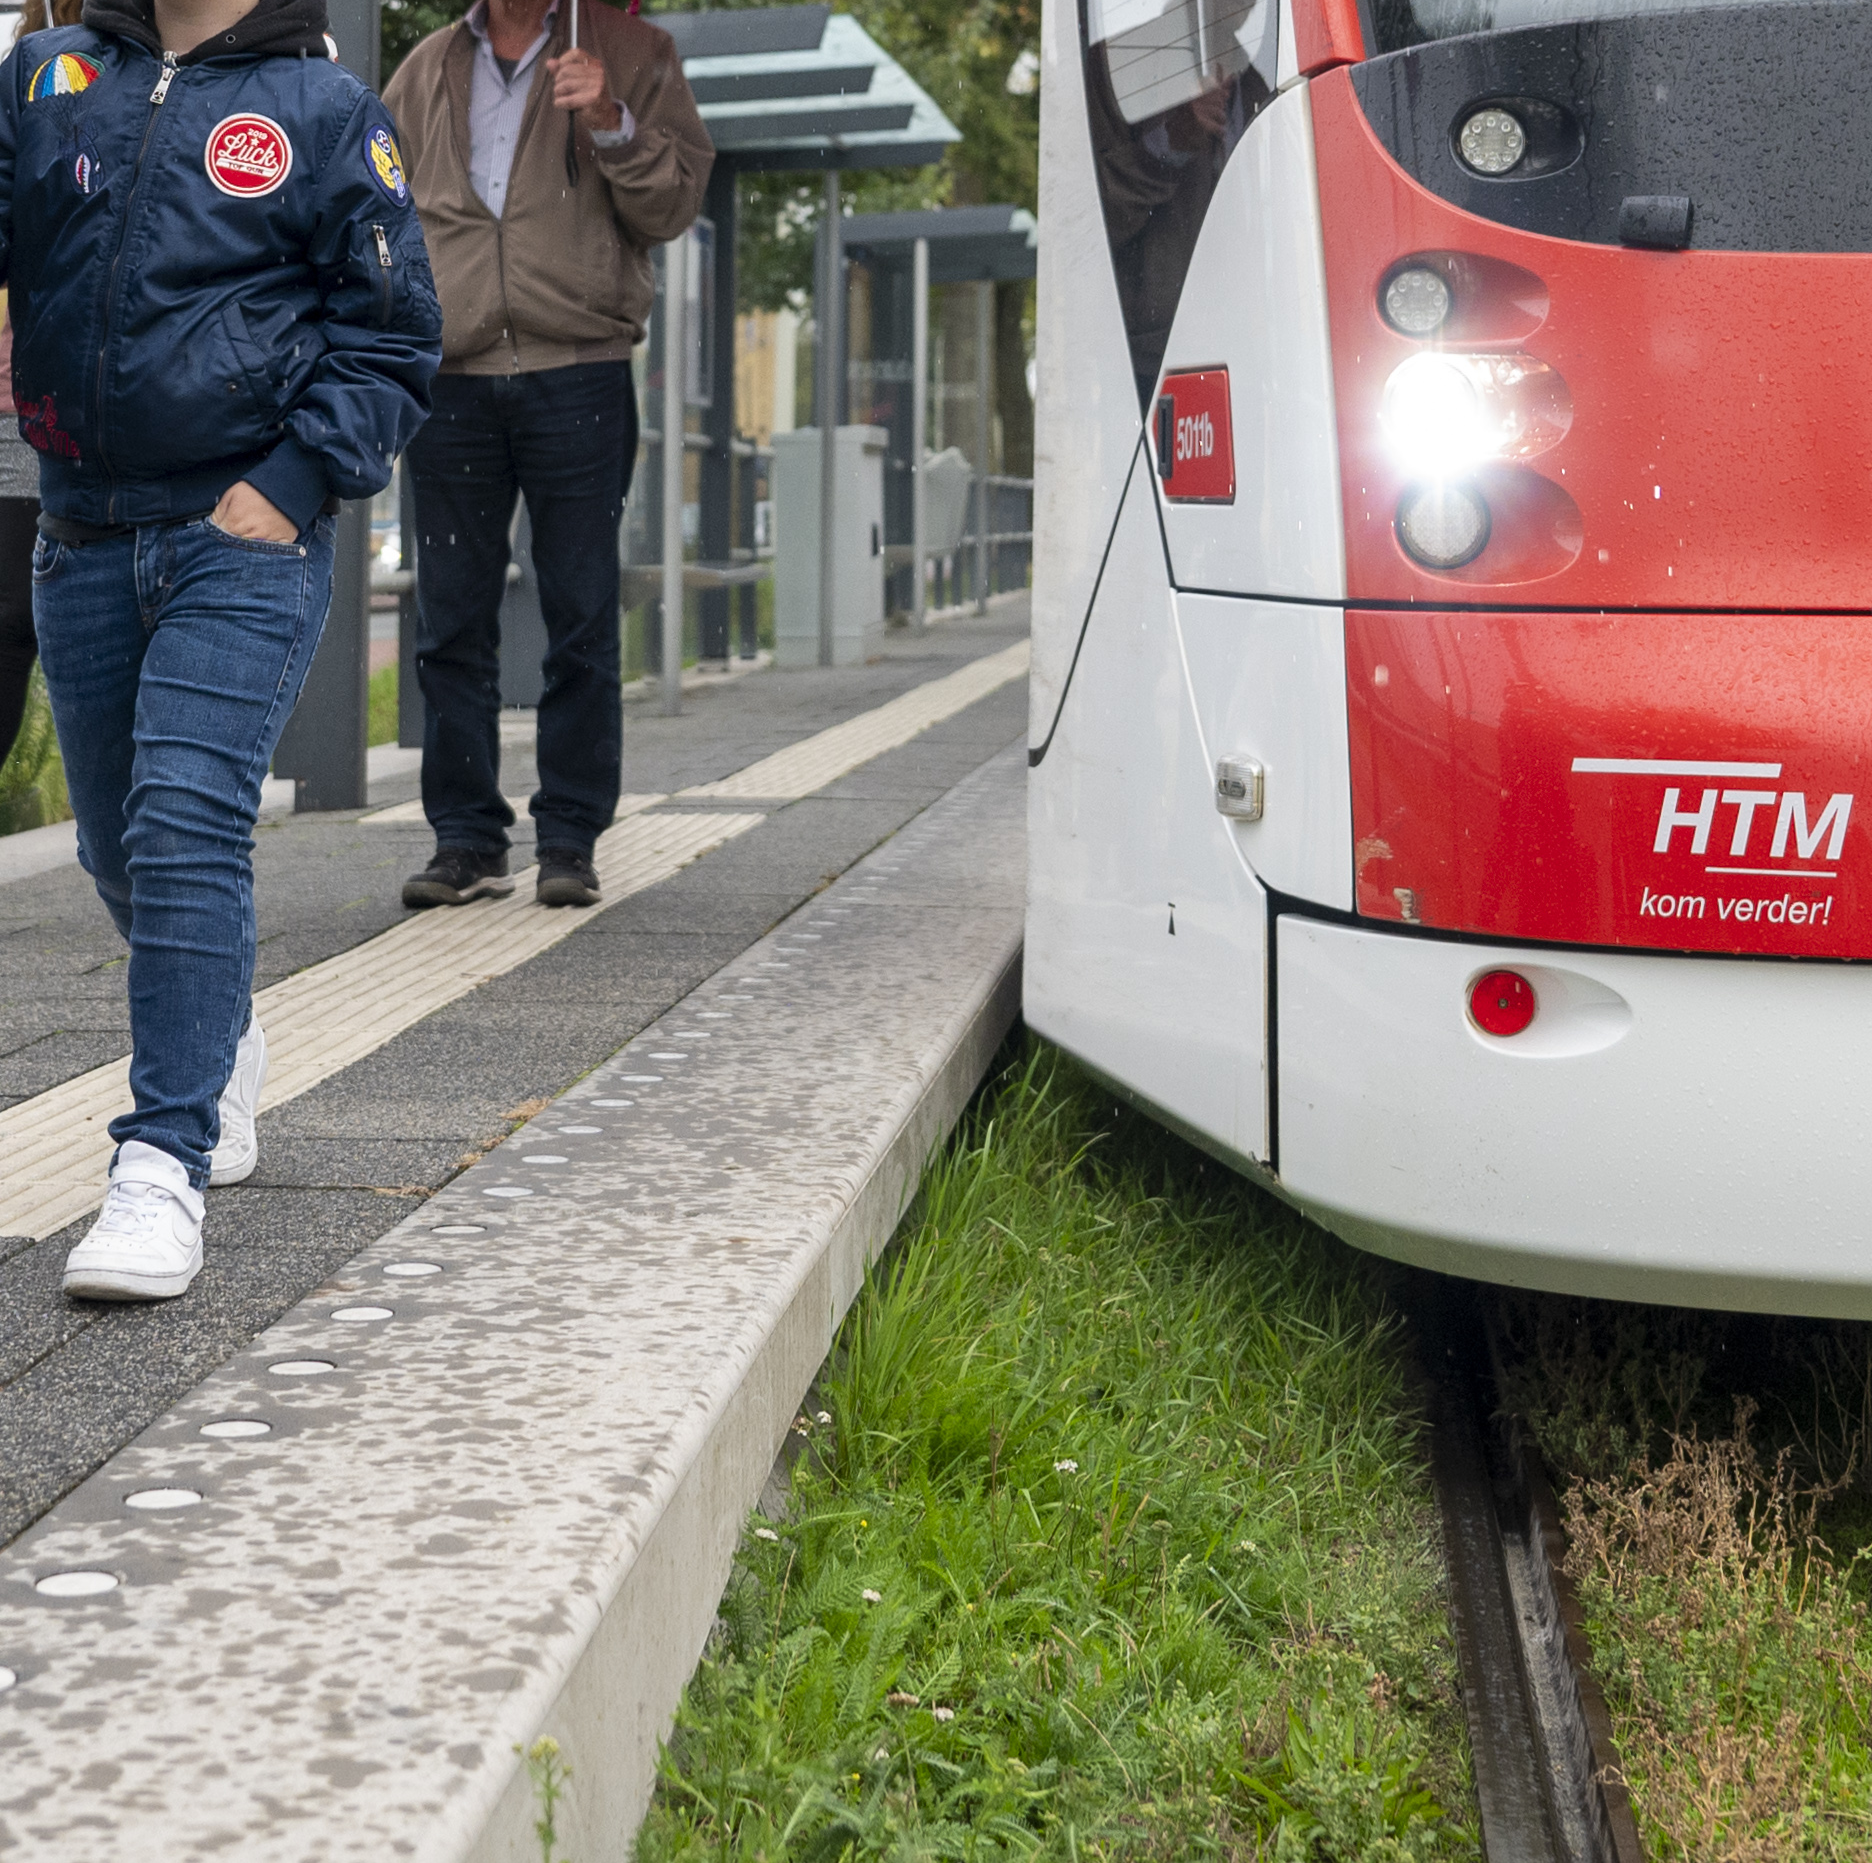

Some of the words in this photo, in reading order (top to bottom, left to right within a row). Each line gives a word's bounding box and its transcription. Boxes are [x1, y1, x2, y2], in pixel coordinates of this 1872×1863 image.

[217, 132, 278, 167] Luck
[1176, 410, 1214, 462] 5011b
[1652, 787, 1854, 860] HTM
[1639, 886, 1706, 919] kom
[1717, 893, 1833, 926] verder!
